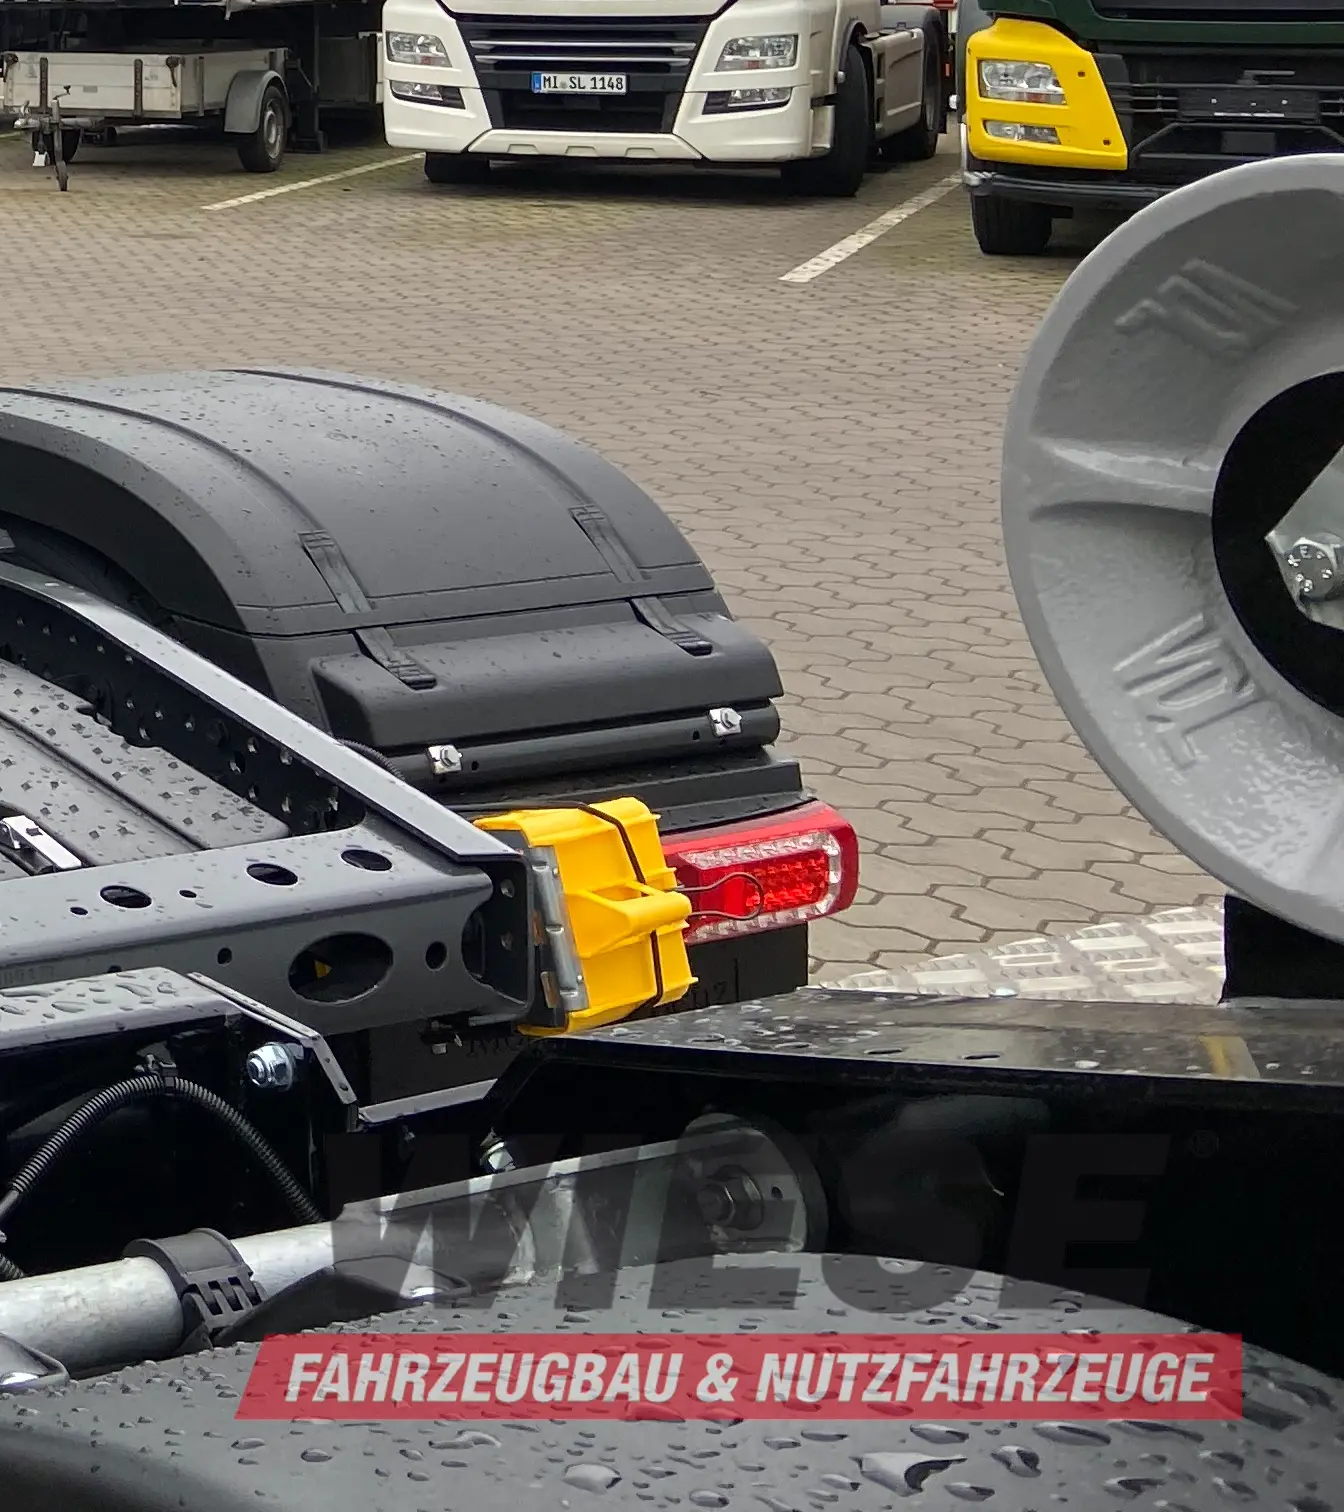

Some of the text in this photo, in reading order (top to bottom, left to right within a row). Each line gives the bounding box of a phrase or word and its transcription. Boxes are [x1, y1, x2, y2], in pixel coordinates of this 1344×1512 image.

[543, 76, 558, 89] MI
[569, 76, 586, 90] SL
[590, 77, 624, 91] 1148
